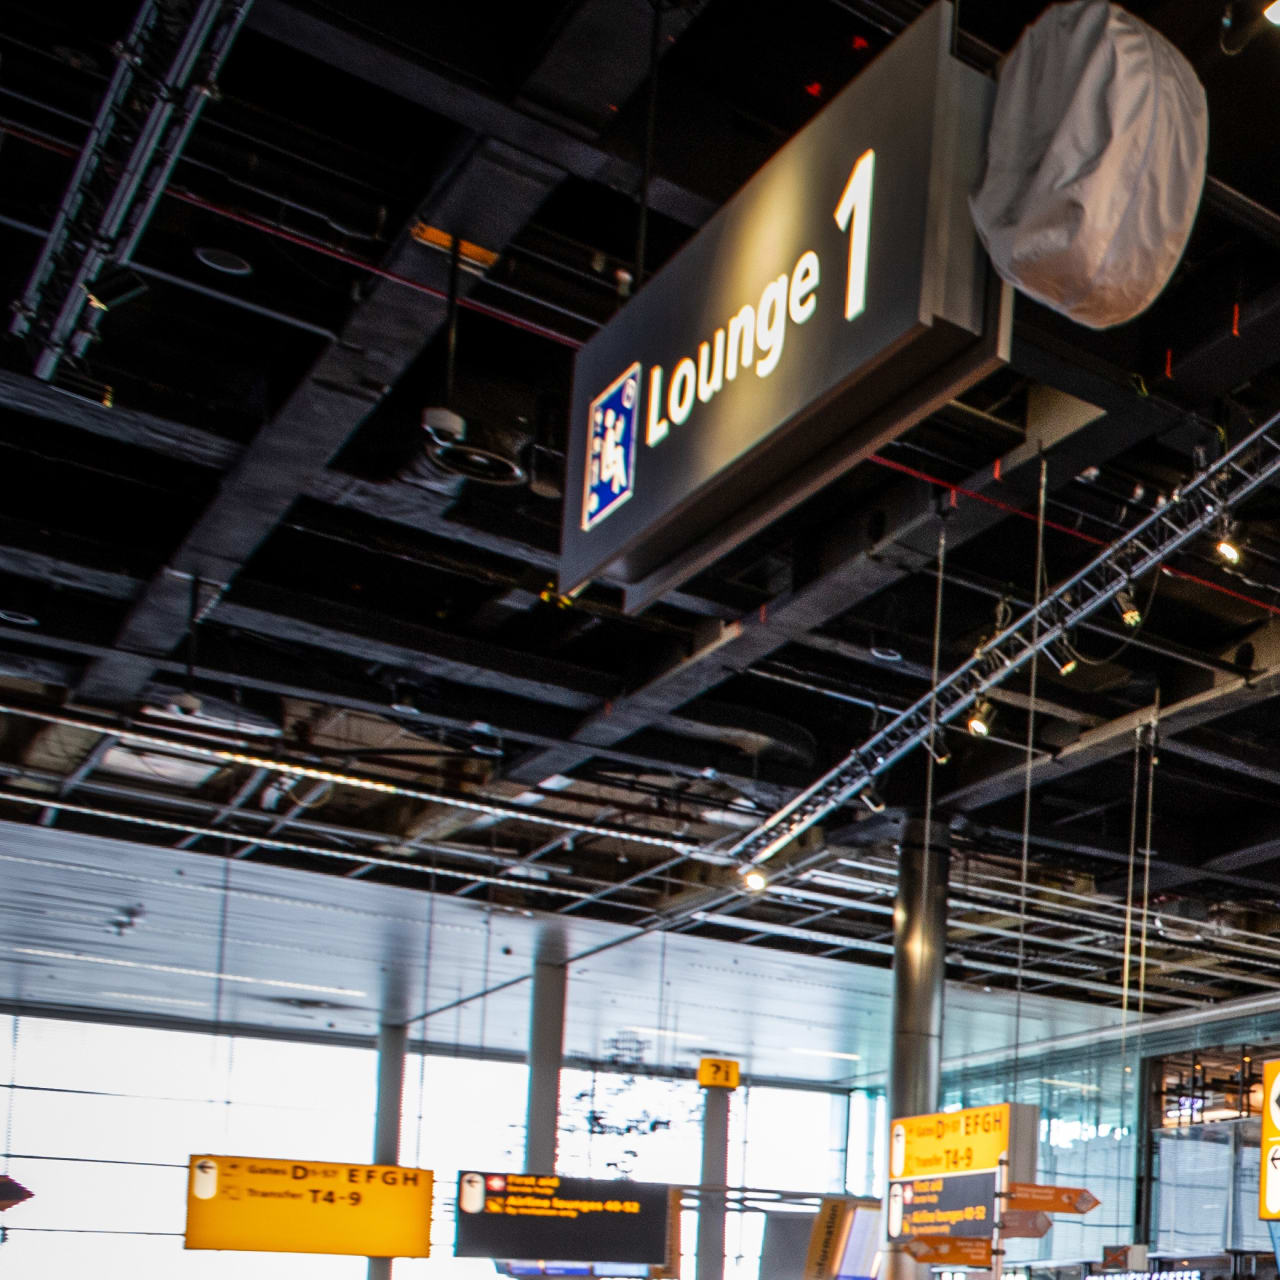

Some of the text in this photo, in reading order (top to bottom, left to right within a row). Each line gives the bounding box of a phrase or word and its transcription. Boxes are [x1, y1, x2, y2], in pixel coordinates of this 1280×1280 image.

[645, 149, 876, 447] Lounge 1
[309, 1189, 362, 1206] T4-9
